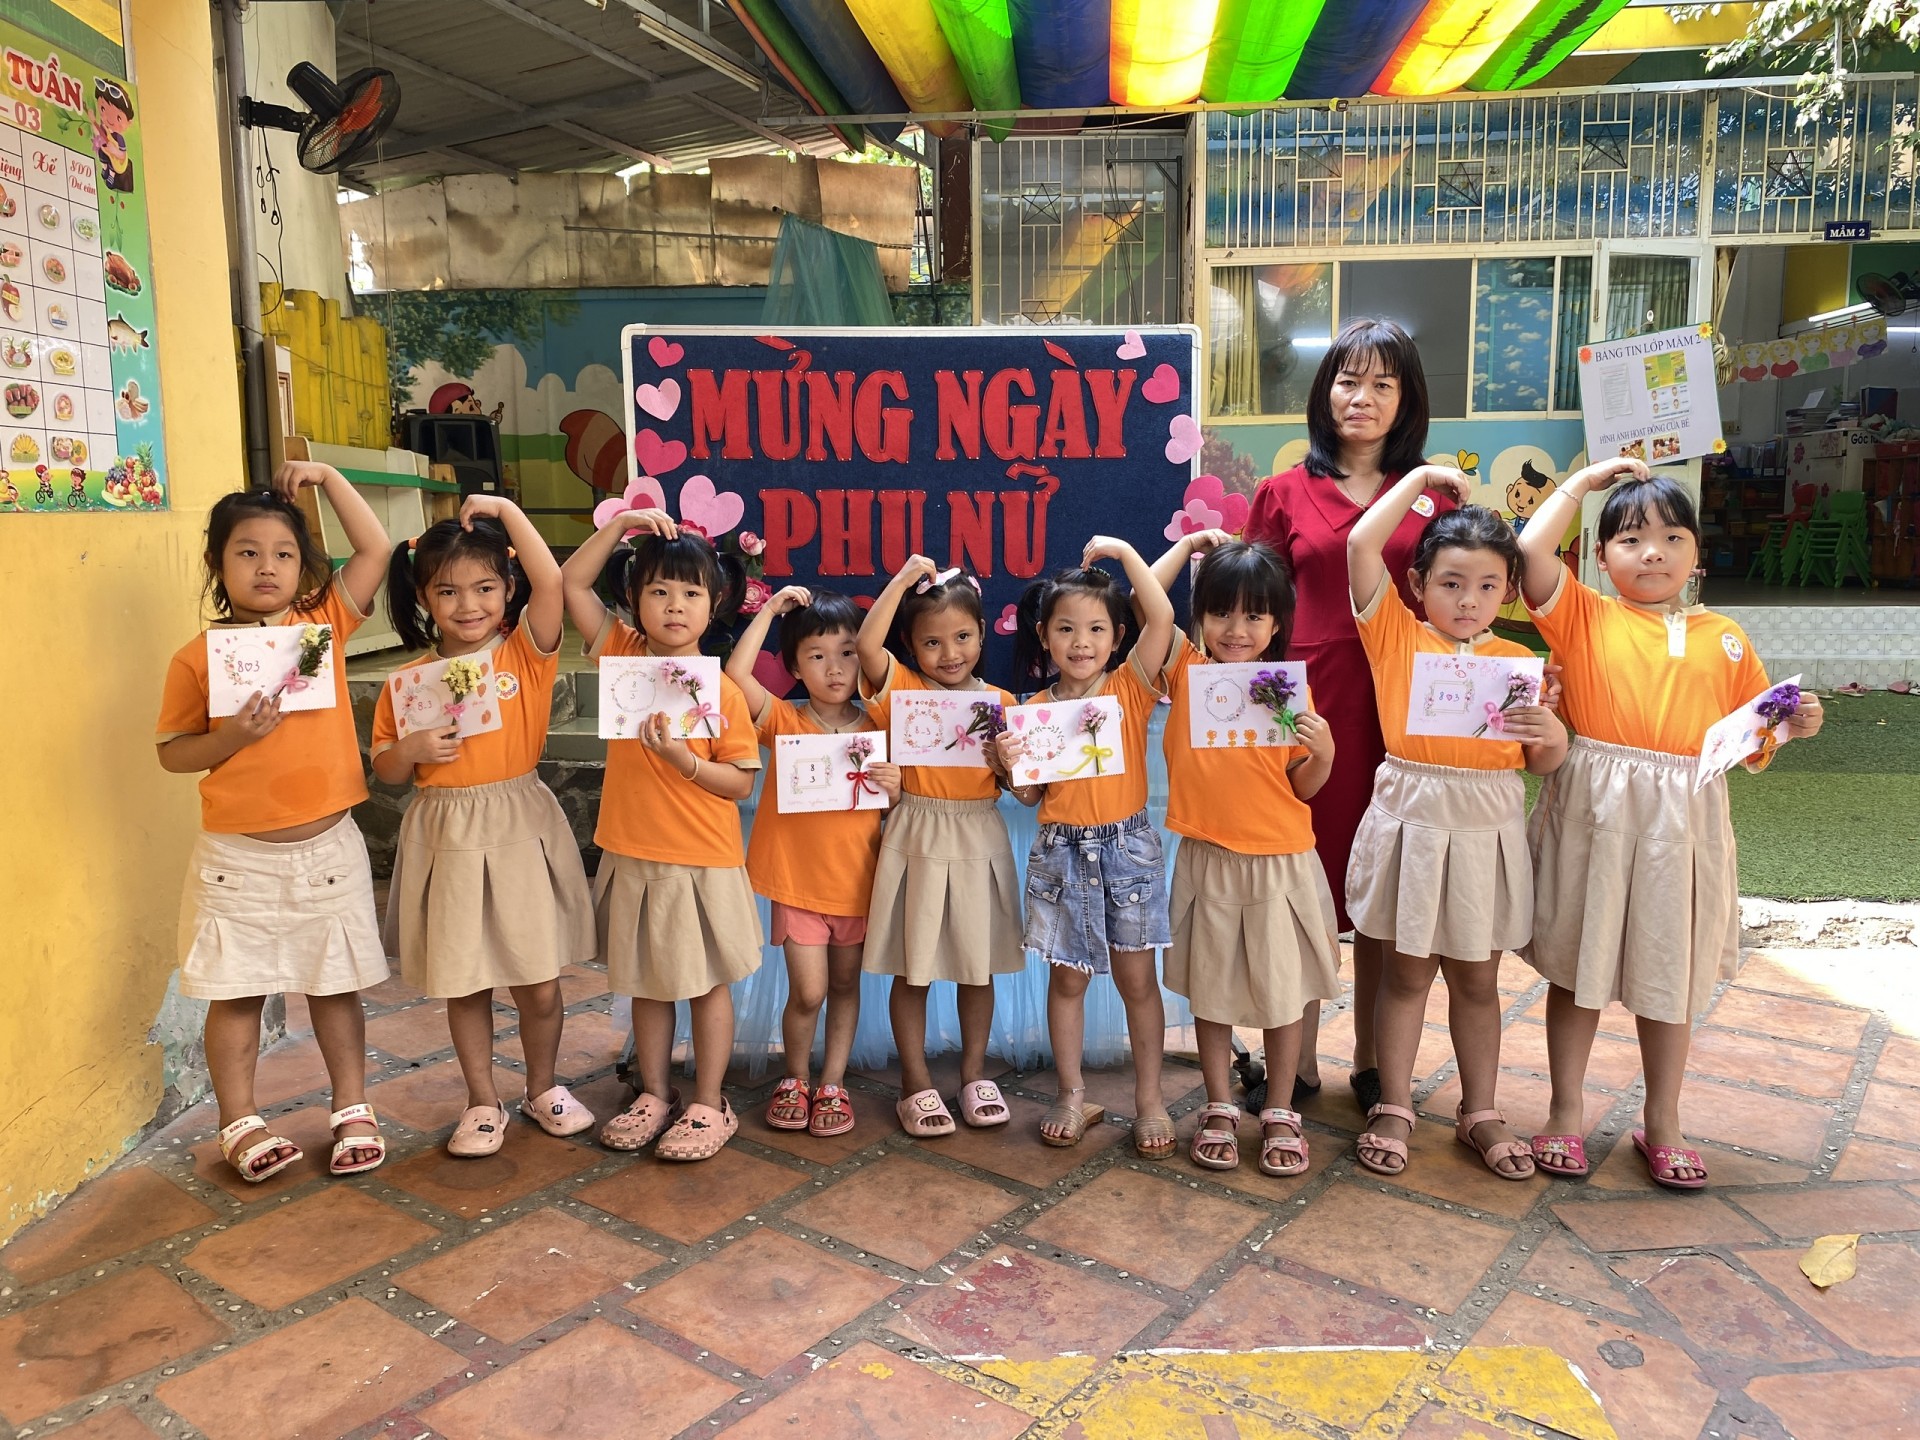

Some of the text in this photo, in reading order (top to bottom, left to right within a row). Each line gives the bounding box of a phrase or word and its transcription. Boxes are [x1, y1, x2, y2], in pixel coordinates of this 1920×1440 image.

[6, 51, 81, 111] TUẦN
[15, 101, 41, 132] 03
[1858, 228, 1866, 237] 2
[1625, 345, 1642, 357] TIN
[1695, 333, 1702, 345] 2
[934, 338, 1137, 460] NGÀY
[1851, 432, 1869, 445] Góc
[946, 463, 1061, 579] NỮ
